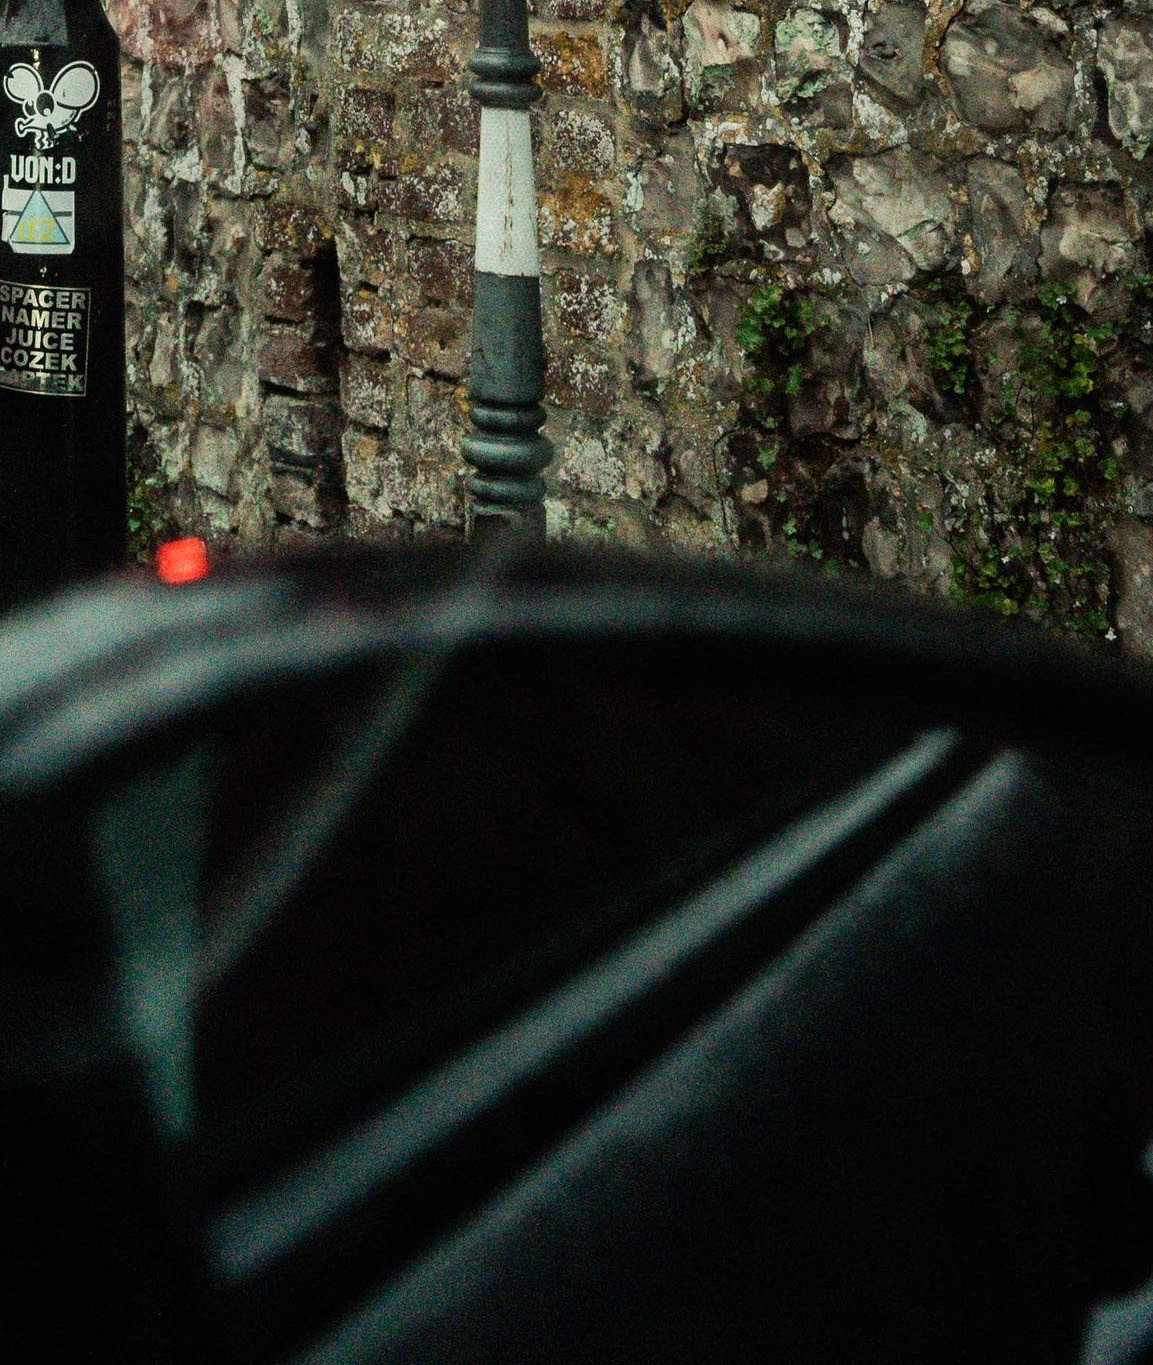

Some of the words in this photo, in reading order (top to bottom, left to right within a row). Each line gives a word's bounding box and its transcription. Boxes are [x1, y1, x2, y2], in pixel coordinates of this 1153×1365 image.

[0, 284, 86, 310] SPACER
[1, 305, 82, 330] NAMER
[5, 328, 75, 351] JUICE
[0, 346, 78, 371] COZEK
